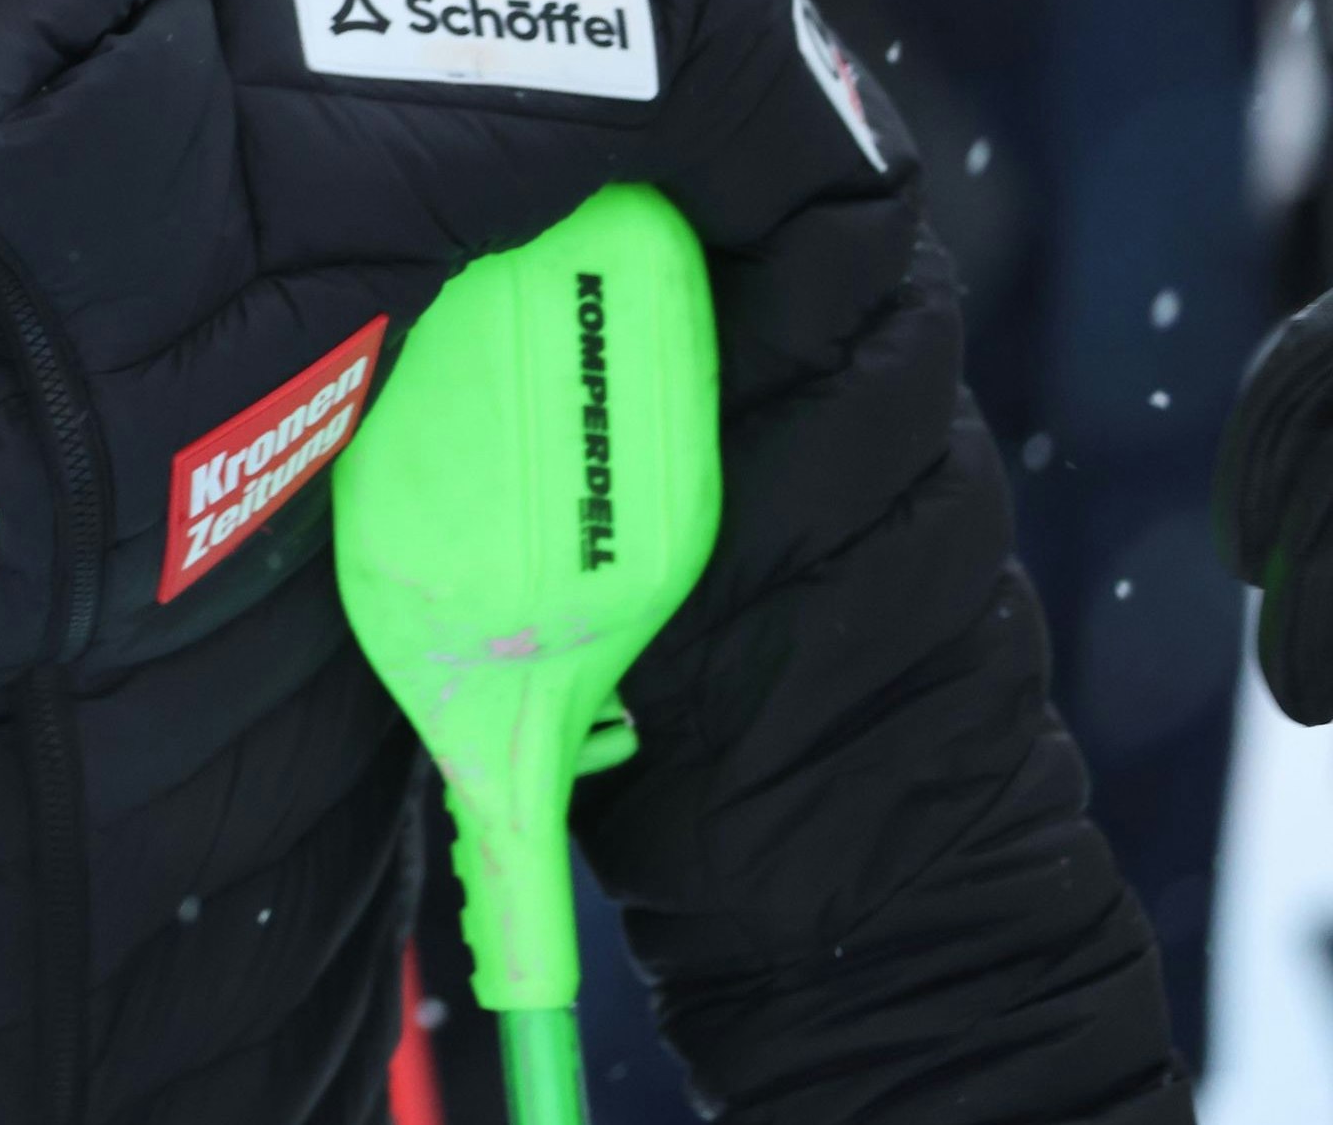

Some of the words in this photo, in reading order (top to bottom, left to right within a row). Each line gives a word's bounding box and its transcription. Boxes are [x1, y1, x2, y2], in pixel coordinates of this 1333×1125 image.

[182, 402, 355, 571] Zeitung
[189, 356, 368, 519] Kronen
[576, 272, 615, 571] KOMPERDELL
